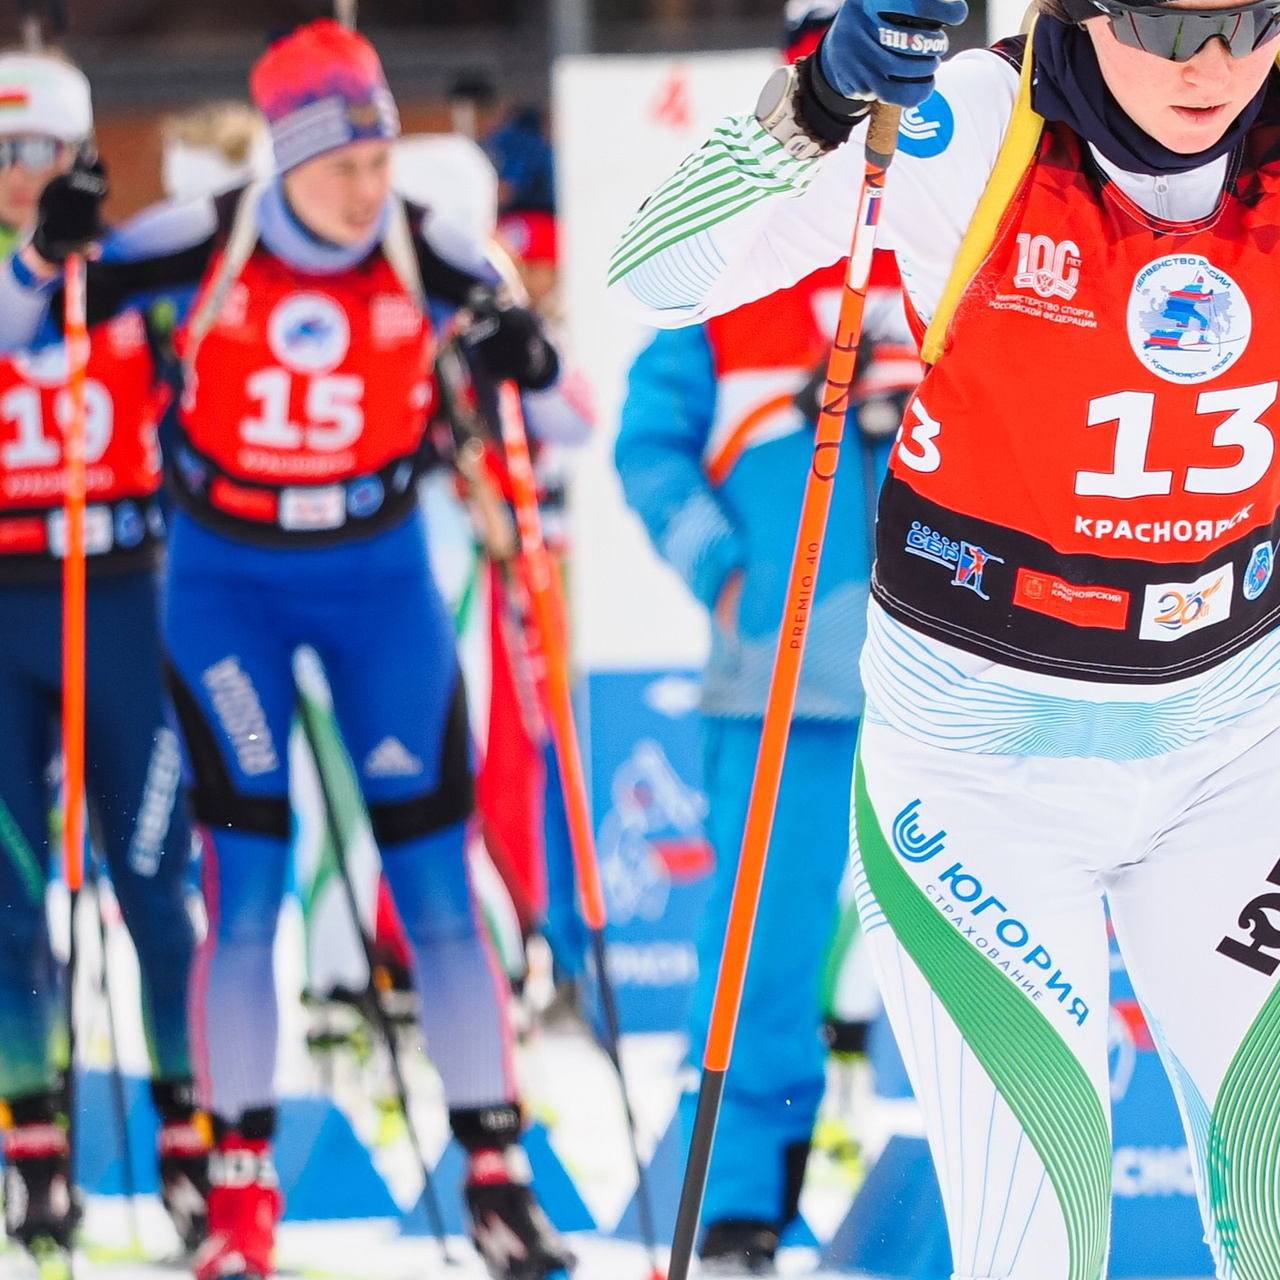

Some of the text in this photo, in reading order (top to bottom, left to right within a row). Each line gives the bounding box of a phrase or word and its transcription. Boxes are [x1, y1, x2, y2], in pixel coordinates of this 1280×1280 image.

[1136, 257, 1196, 293] ПЕРВЕНСТВО
[989, 300, 1097, 329] РОССИЙСКОЙ ФЕДЕРАЦИИ
[995, 294, 1094, 319] МИНИСТЕРСТВО СПОРТА
[0, 378, 115, 468] 19
[238, 366, 367, 452] 15
[1074, 380, 1279, 499] 13
[1074, 503, 1255, 543] КРАСНОЯРСК
[906, 528, 961, 562] СБР
[790, 575, 813, 649] PREMIO
[1051, 589, 1073, 602] КРАЙ
[1052, 581, 1122, 603] КРАСНОЯРСКИЙ
[925, 884, 1043, 1002] СТРАХОВАНИЕ
[938, 862, 1090, 1027] ЮГОРИЯ
